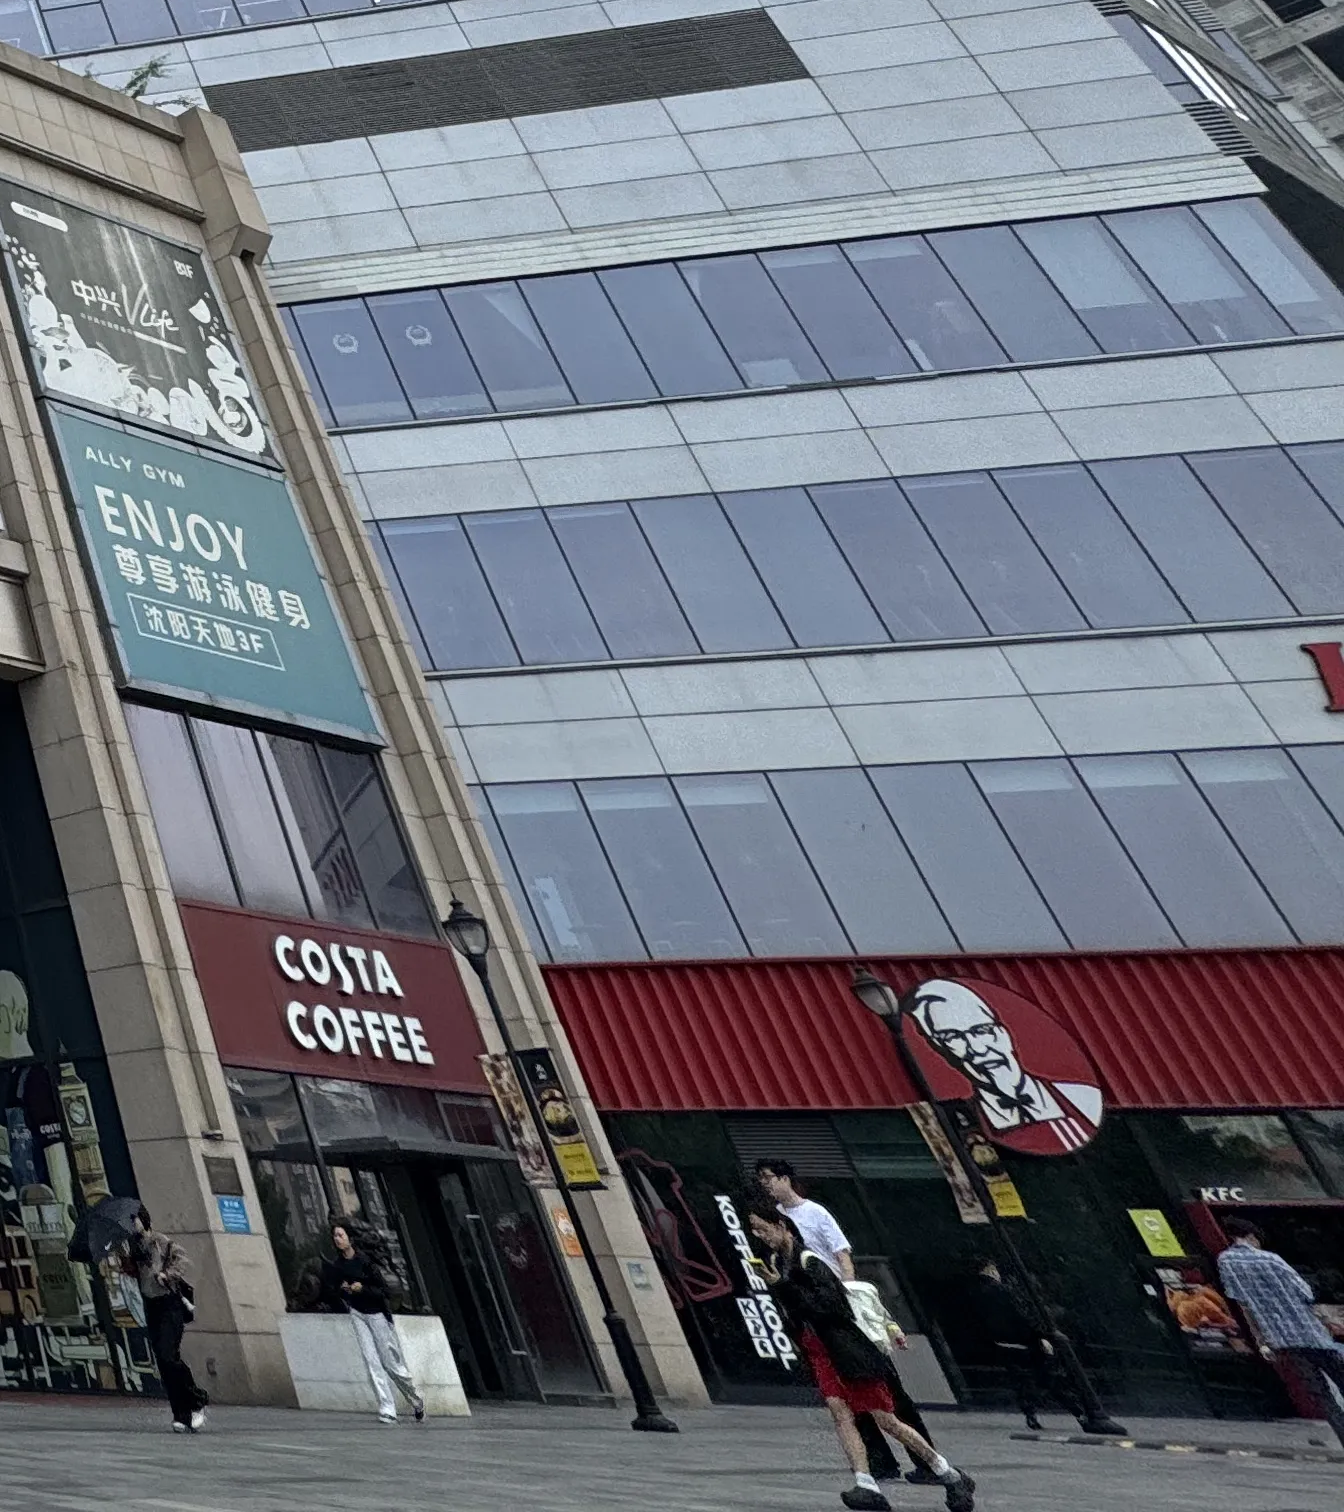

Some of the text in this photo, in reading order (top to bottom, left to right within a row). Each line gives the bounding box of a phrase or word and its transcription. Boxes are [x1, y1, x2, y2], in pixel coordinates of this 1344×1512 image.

[85, 446, 186, 488] ALLY GYM
[94, 484, 248, 571] ENJOY
[112, 544, 310, 630] 尊享游泳健身
[142, 603, 265, 654] 沈阳天地3F
[272, 934, 404, 998] COSTA
[287, 1000, 435, 1066] COFFEE
[1200, 1187, 1246, 1202] KFC
[713, 1195, 798, 1371] KOFFEE KOOL
